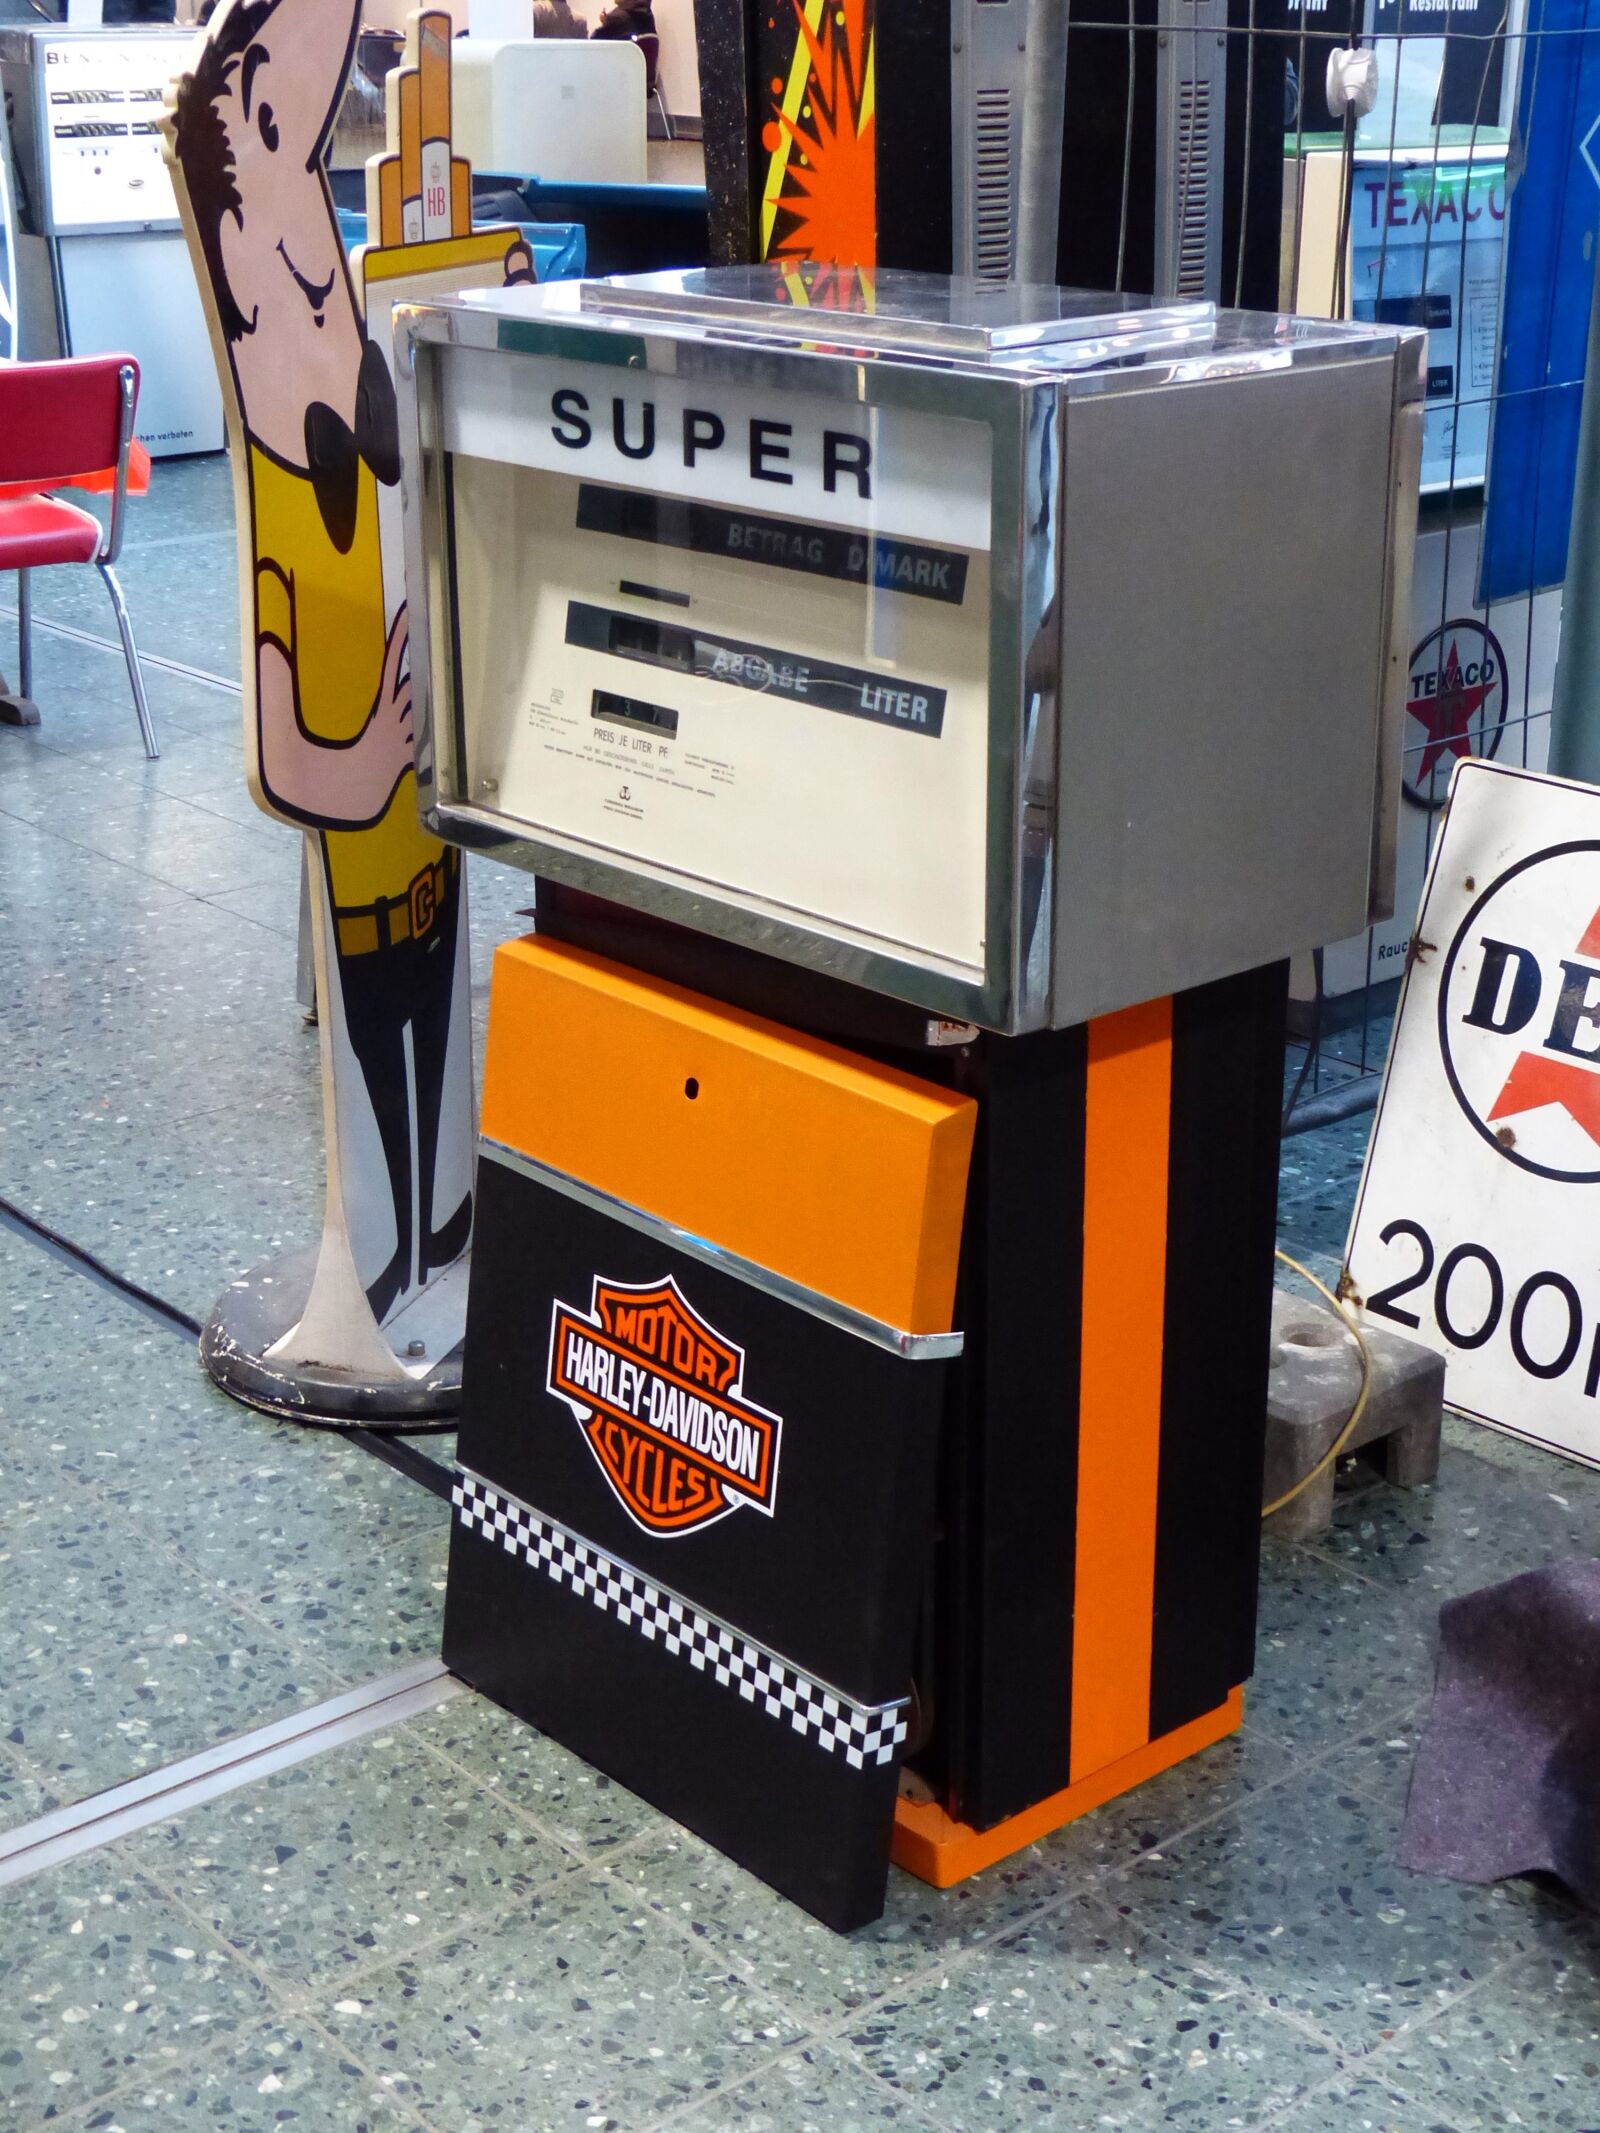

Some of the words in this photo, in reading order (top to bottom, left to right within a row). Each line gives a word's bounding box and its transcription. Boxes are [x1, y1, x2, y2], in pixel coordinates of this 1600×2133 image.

[427, 187, 446, 217] HB
[1364, 181, 1505, 228] TEXACO
[157, 429, 194, 441] verboten
[551, 389, 873, 499] SUPER
[728, 523, 824, 565] BETRAG
[712, 648, 810, 693] ABGABE
[860, 682, 929, 724] LITER
[1411, 659, 1494, 698] TEXACO
[594, 727, 615, 744] PREIS
[619, 734, 629, 747] JE
[632, 738, 652, 754] LITER
[1366, 1218, 1600, 1398] 200
[616, 1305, 717, 1388] MOTOR
[565, 1332, 761, 1481] HARLEY-DAVIDSON
[604, 1424, 706, 1514] CYCLES
